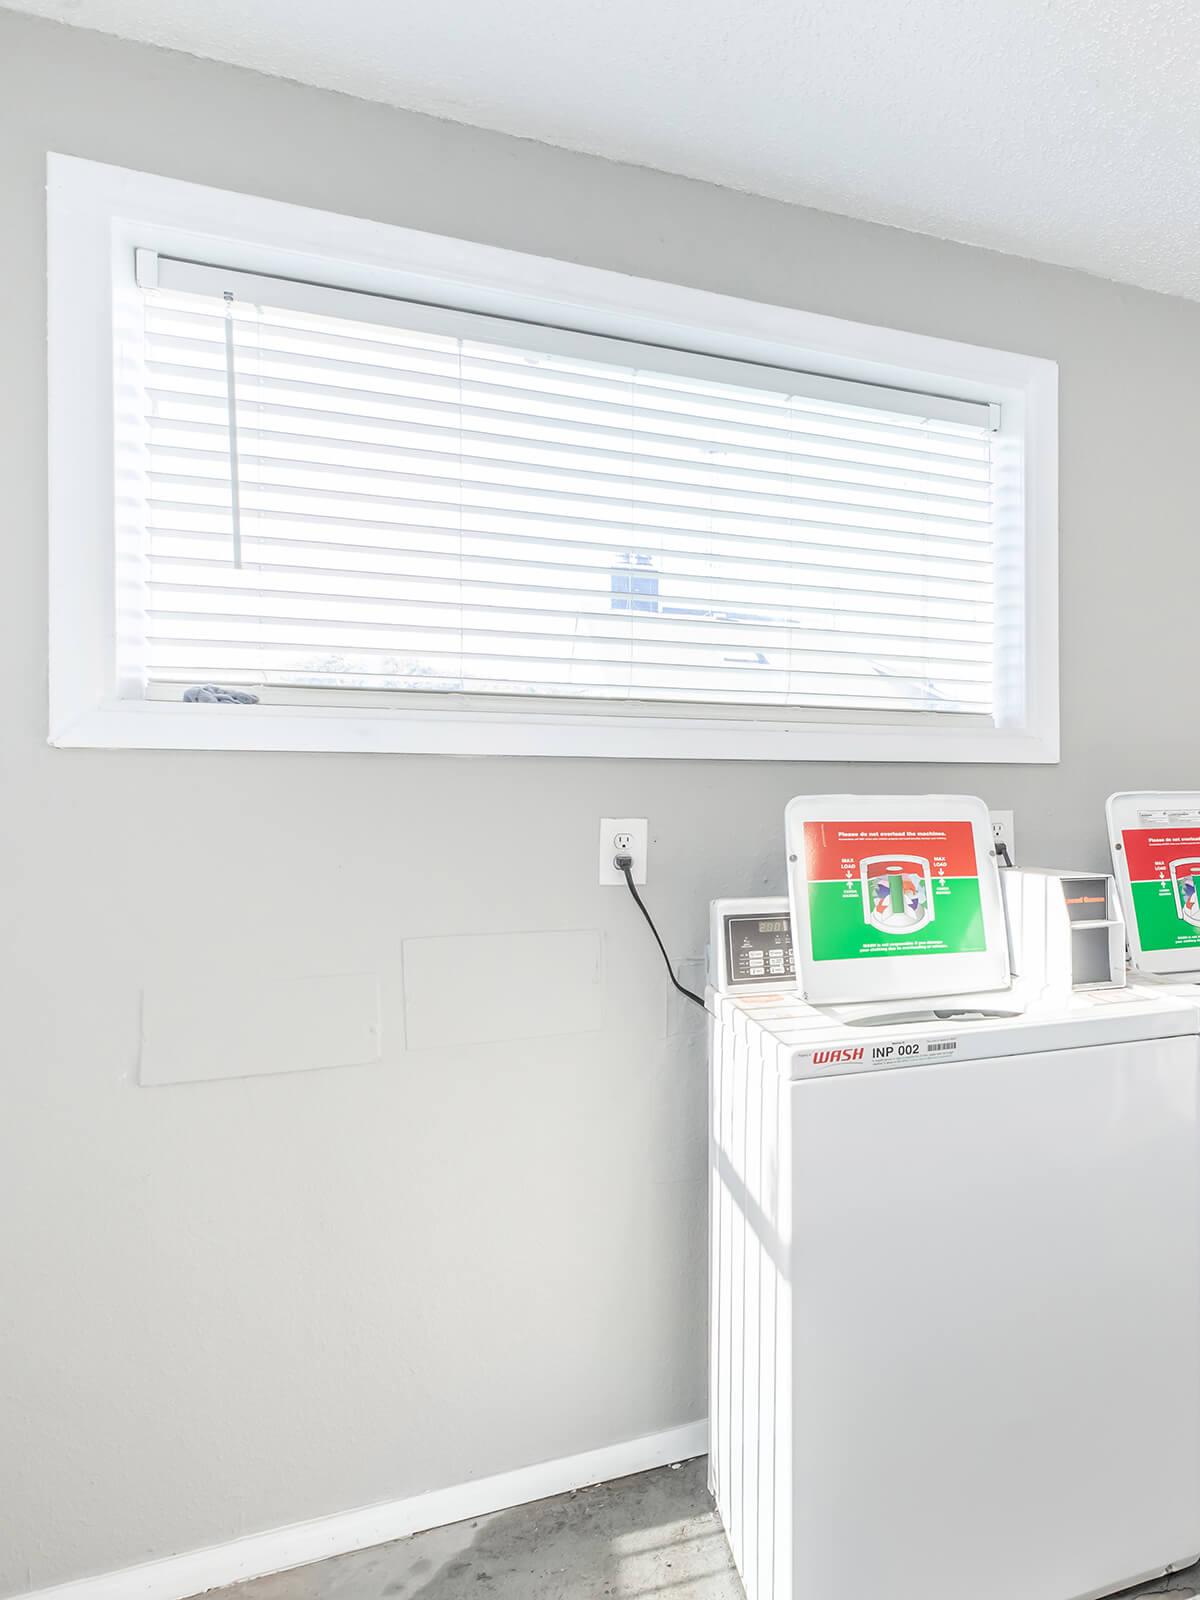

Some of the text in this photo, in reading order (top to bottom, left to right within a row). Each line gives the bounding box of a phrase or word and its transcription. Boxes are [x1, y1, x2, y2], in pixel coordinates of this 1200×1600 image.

[812, 1047, 864, 1065] WASH
[872, 1046, 894, 1058] INP
[898, 1044, 920, 1056] 002
